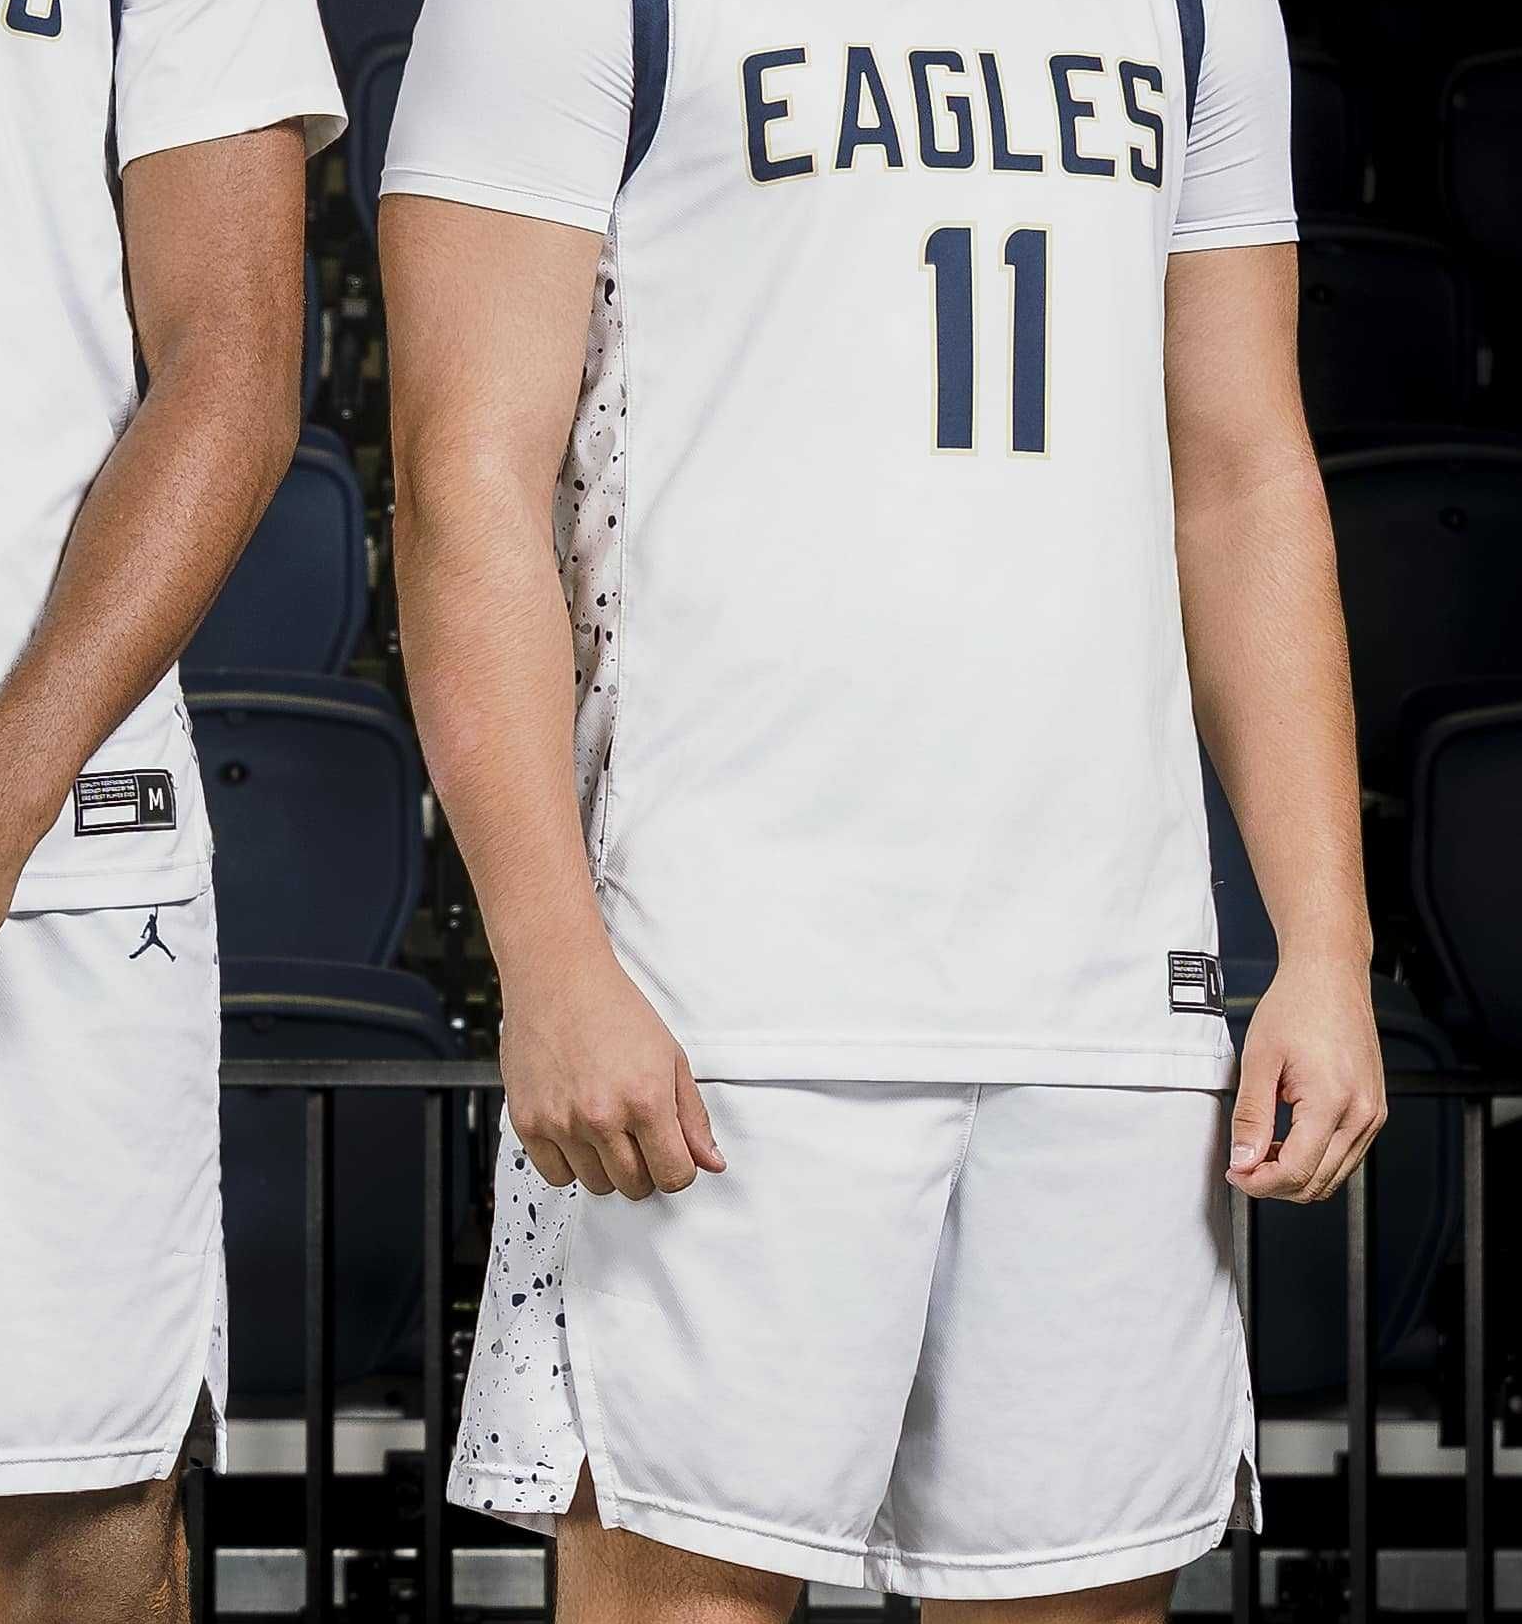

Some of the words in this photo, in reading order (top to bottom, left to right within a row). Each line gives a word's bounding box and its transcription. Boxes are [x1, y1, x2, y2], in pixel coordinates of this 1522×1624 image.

[739, 42, 1165, 194] EAGLES
[918, 221, 1053, 460] 11
[148, 788, 165, 811] M
